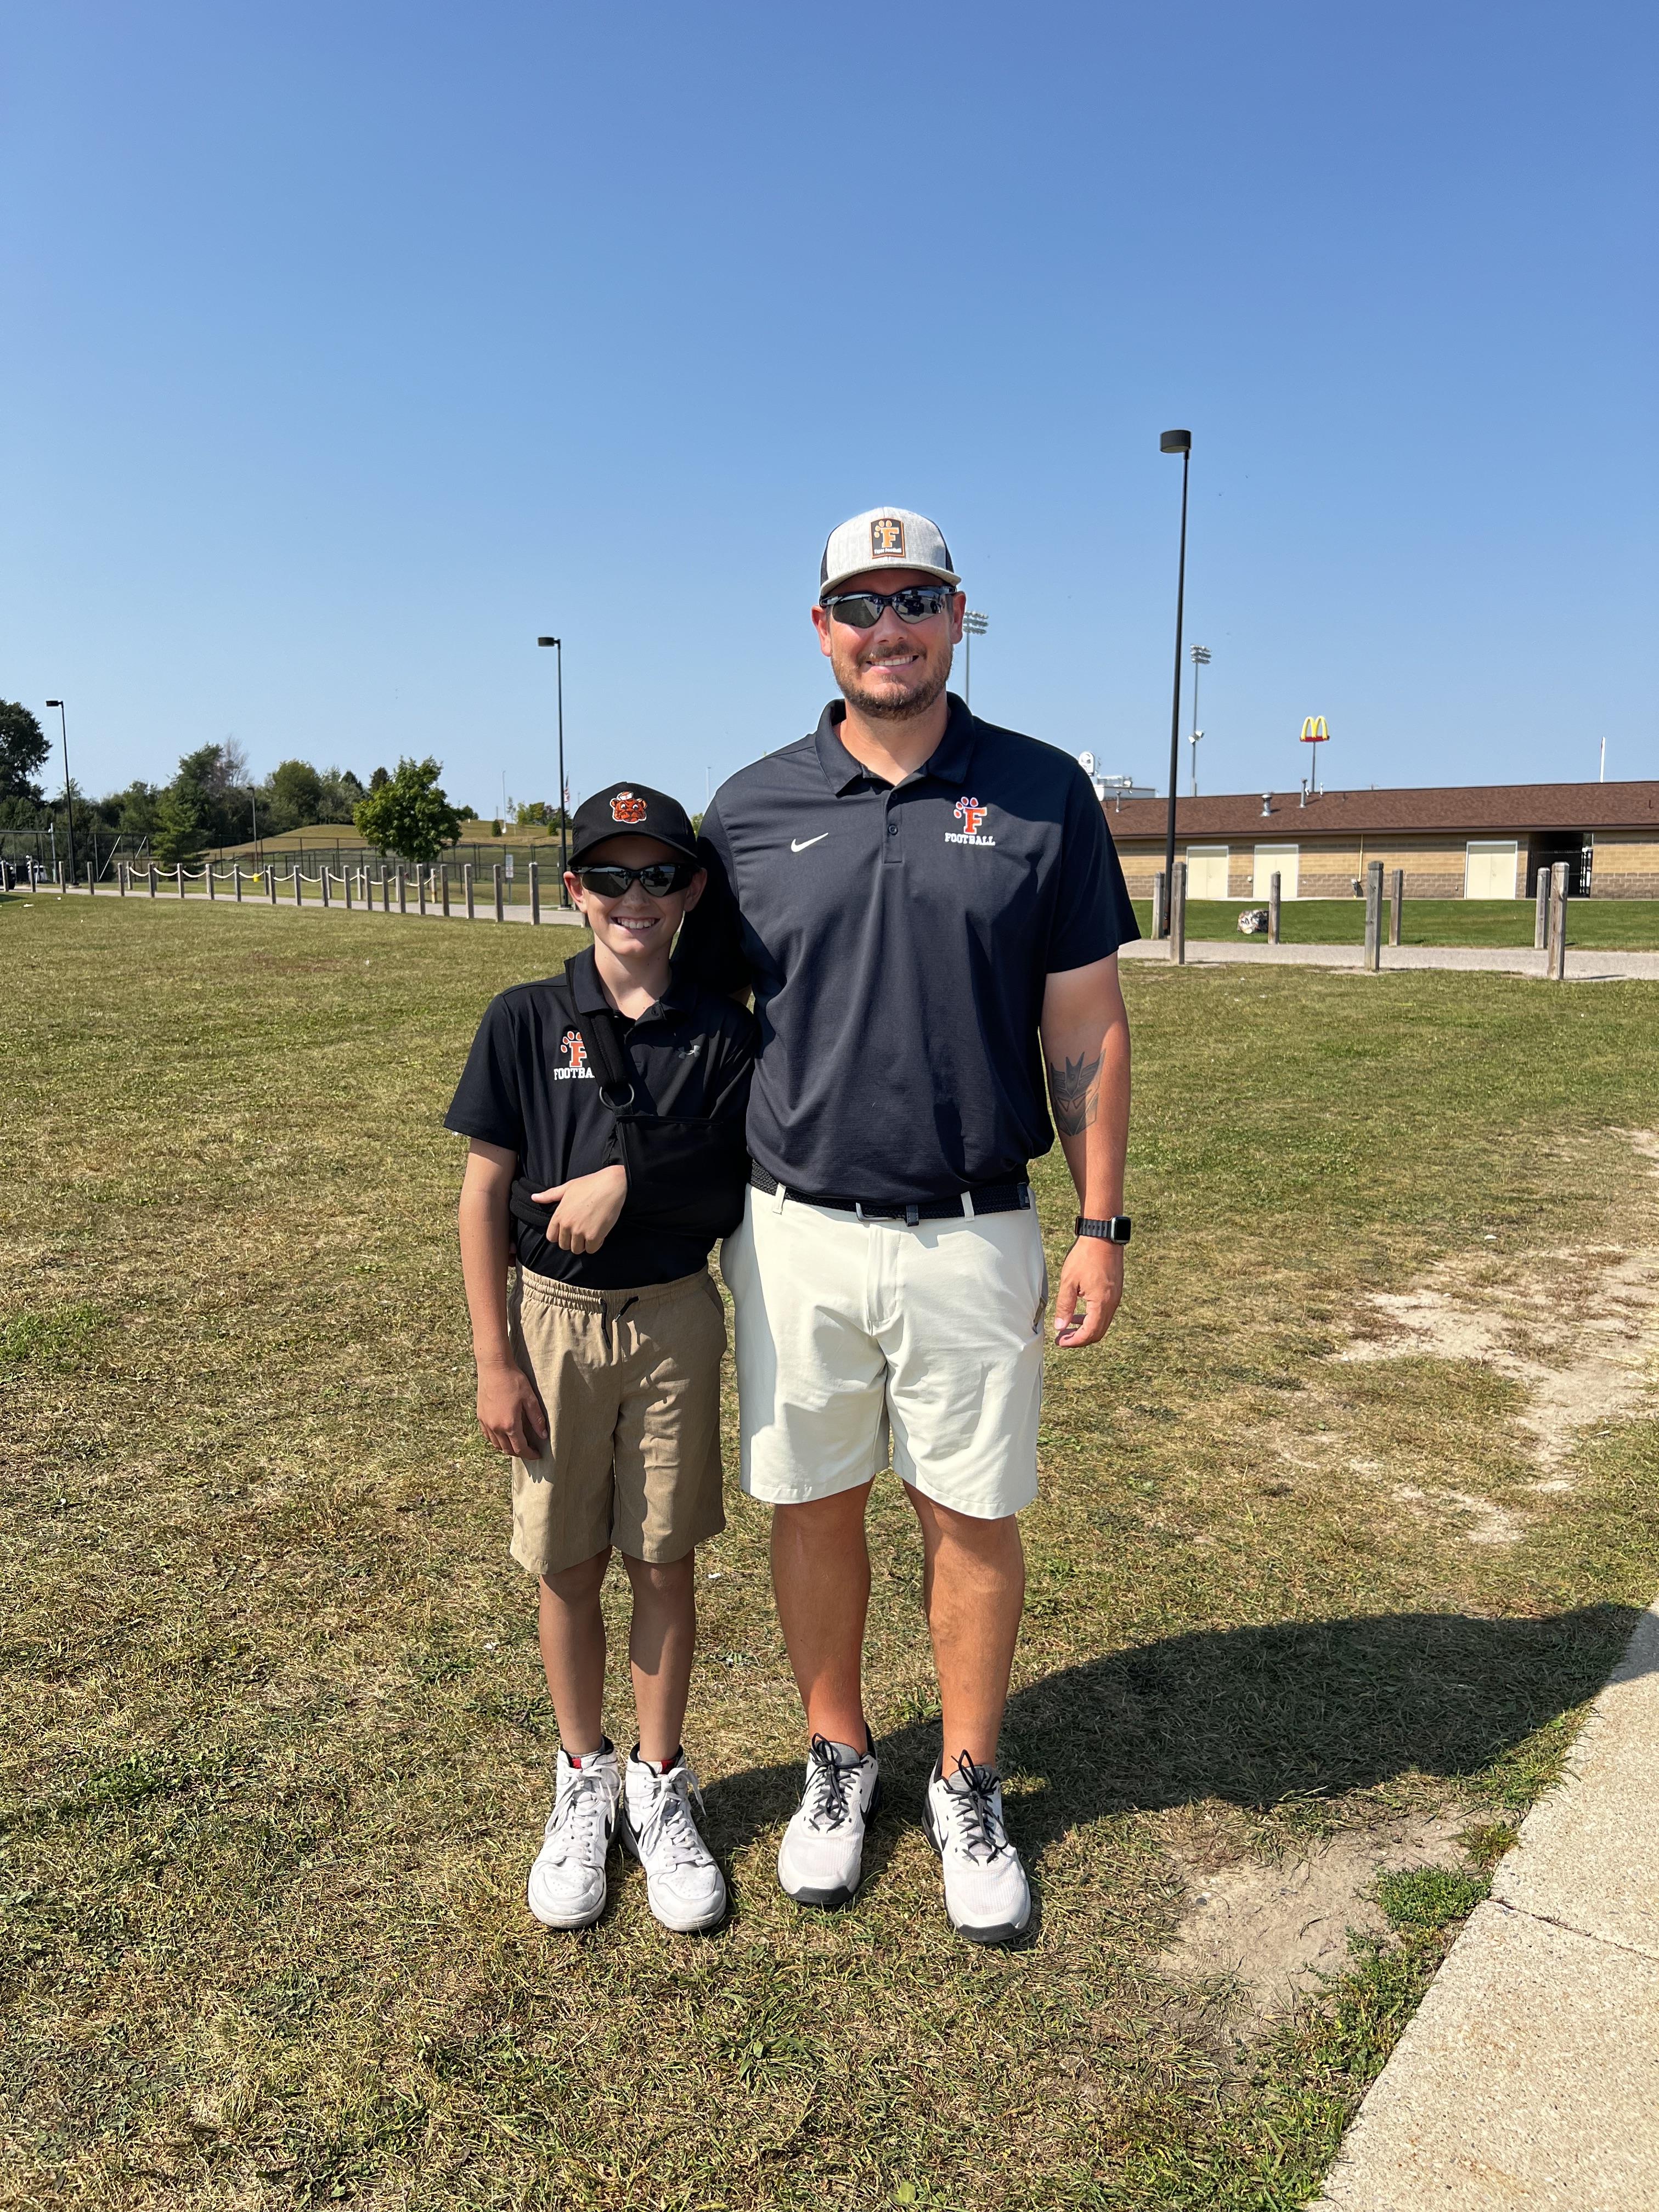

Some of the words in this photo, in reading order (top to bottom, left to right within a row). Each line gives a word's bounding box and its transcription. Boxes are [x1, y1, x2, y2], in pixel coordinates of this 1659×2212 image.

[881, 527, 899, 548] F
[963, 806, 987, 834] F
[945, 832, 996, 846] FOOTBALL
[569, 1041, 587, 1068] F
[554, 1067, 595, 1081] FOOTBA
